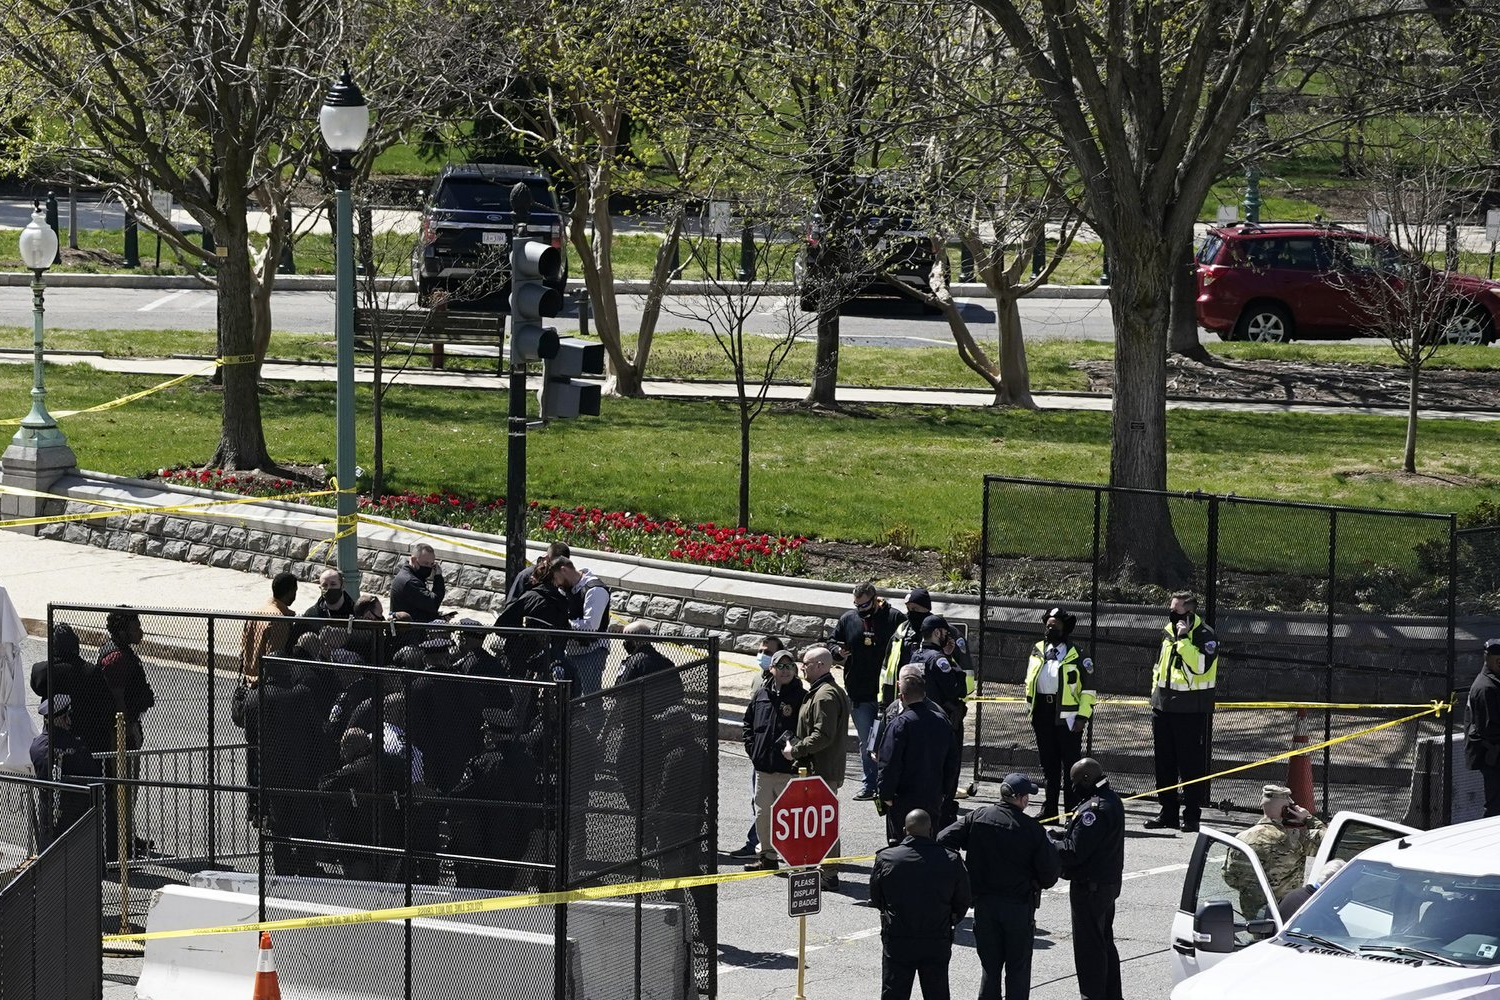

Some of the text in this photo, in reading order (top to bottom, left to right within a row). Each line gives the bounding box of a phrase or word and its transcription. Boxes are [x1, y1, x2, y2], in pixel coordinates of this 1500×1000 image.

[776, 804, 835, 840] STOP
[794, 878, 816, 888] PLEASE
[794, 888, 816, 898] DISPLAY
[792, 898, 818, 908] ID BADGE
